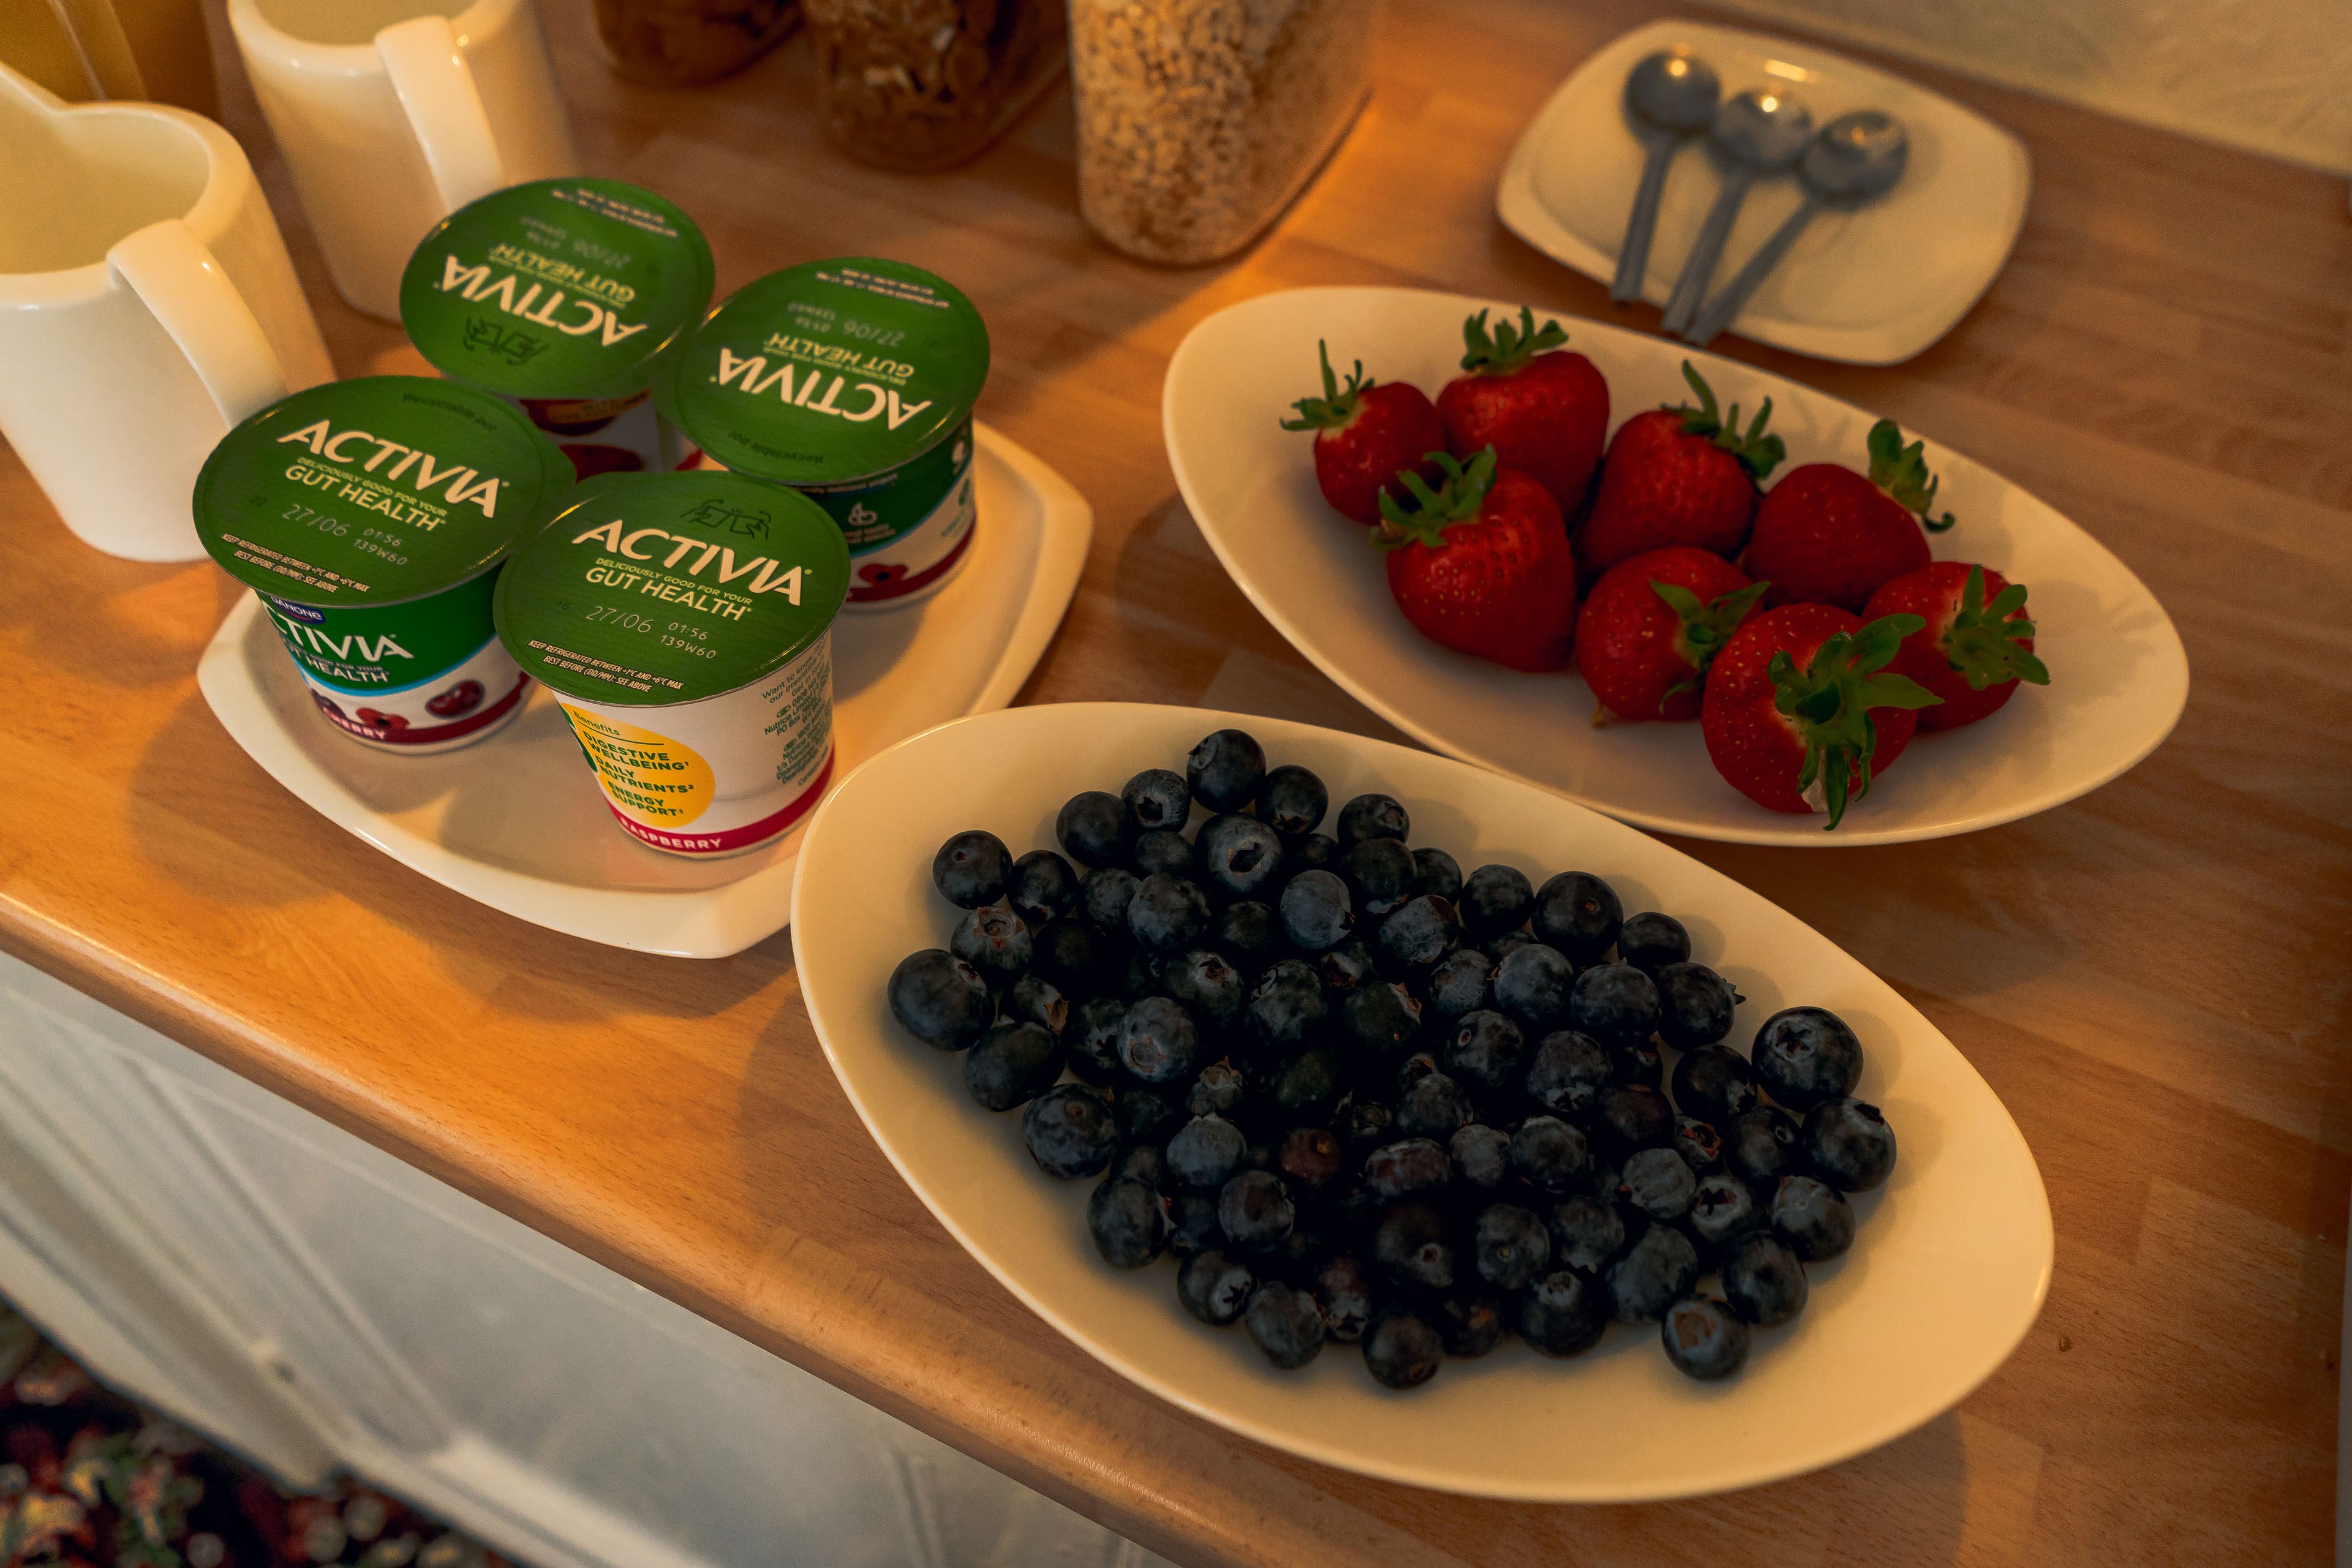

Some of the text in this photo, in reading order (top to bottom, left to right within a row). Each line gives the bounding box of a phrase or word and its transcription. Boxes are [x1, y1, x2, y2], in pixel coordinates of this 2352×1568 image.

[442, 255, 648, 347] ACTIVIA
[768, 333, 862, 364] HEALTH
[862, 356, 914, 378] GUT
[718, 347, 932, 431] ACTIVIA
[277, 419, 500, 518] ACTIVIA
[285, 465, 442, 532] GUT HEALTH
[282, 502, 351, 536] 27/06
[571, 519, 803, 606] ACTIVIA
[586, 567, 748, 621] GUT HEALTH
[595, 557, 752, 605] DELICIOUSLY GOOD FOR YOUR
[262, 600, 415, 662] CTIVIA
[586, 606, 654, 633] 27/06
[668, 622, 709, 640] 01:56
[660, 635, 717, 659] 139W60
[306, 656, 388, 682] HEALTH
[528, 639, 546, 649] KEEP
[545, 644, 592, 664] REFRIGERATED
[590, 658, 623, 673] BETWEEN
[636, 672, 652, 681] AND
[666, 680, 684, 690] MAX
[543, 655, 652, 693] BEST BEFORE (DD/MM): SEE ABOVE
[762, 681, 785, 698] Want
[769, 691, 784, 703] our
[573, 710, 620, 736] Benefits
[583, 731, 669, 761] DIGESTIVE
[595, 755, 635, 778] DAILY
[607, 780, 665, 807] ENERGY
[620, 816, 722, 850] RASPBERRY
